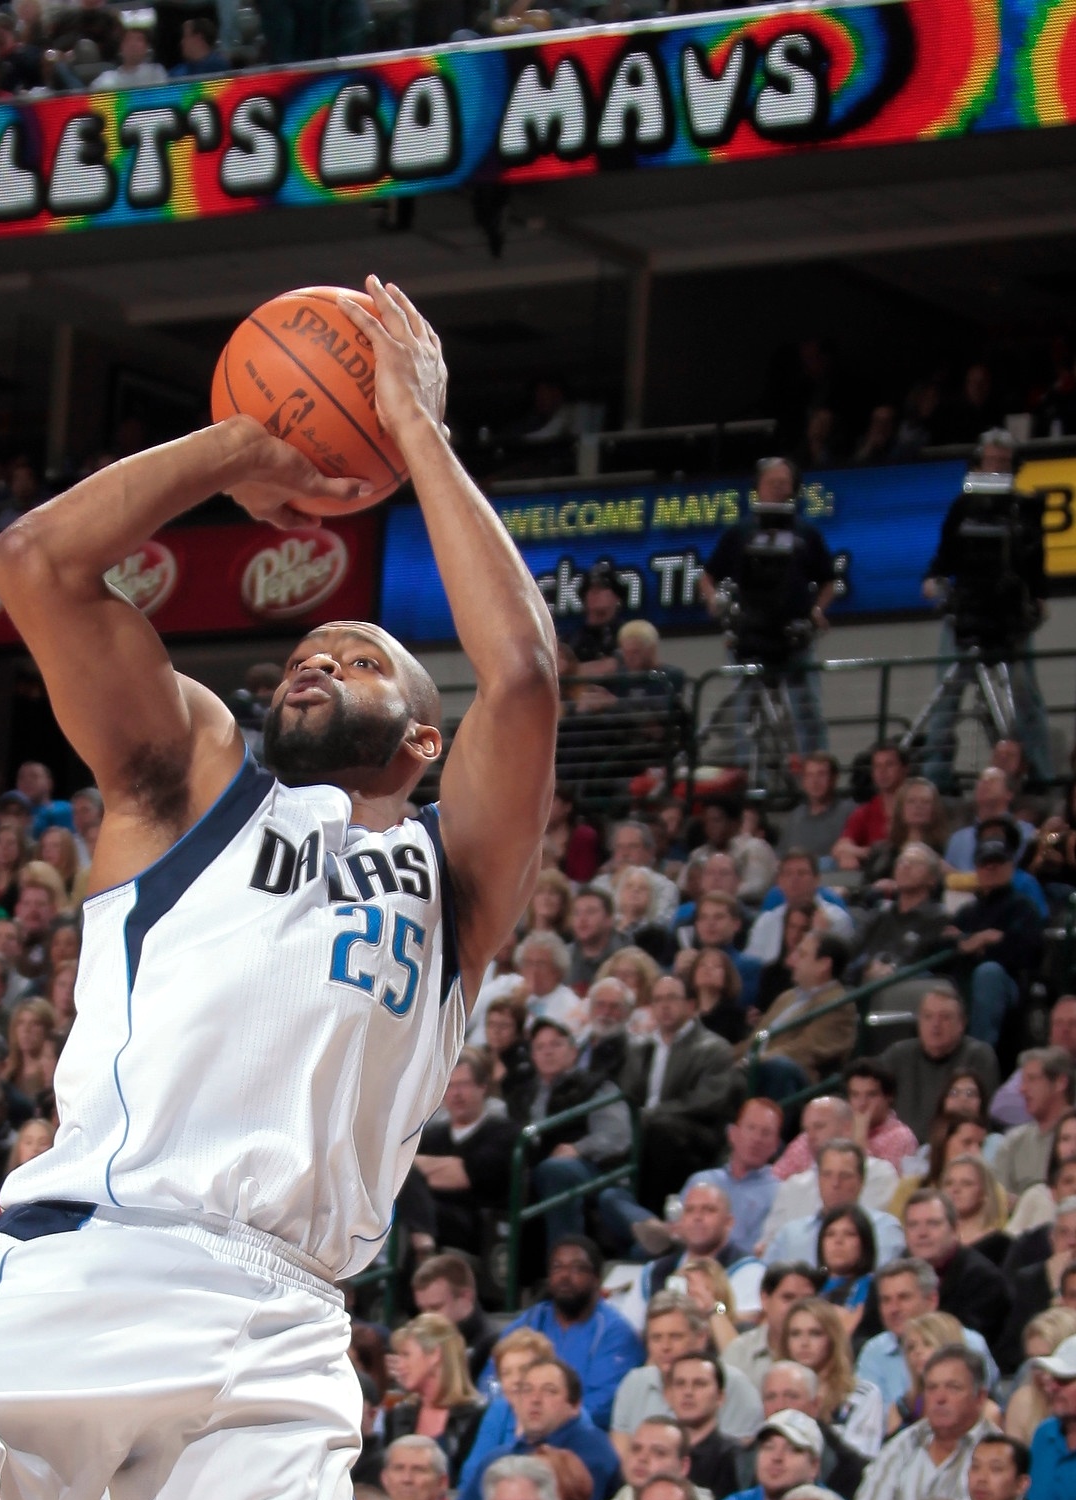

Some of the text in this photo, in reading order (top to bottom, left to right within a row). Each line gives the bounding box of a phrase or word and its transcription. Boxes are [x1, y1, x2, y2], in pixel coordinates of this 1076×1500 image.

[321, 75, 454, 180] GO
[500, 33, 818, 158] MAVS
[281, 305, 381, 432] SPALDI
[502, 499, 645, 539] WELCOME
[651, 491, 739, 528] MAVS
[253, 539, 336, 611] Dr Pepper
[248, 825, 433, 904] DALAS
[329, 904, 426, 1020] 25
